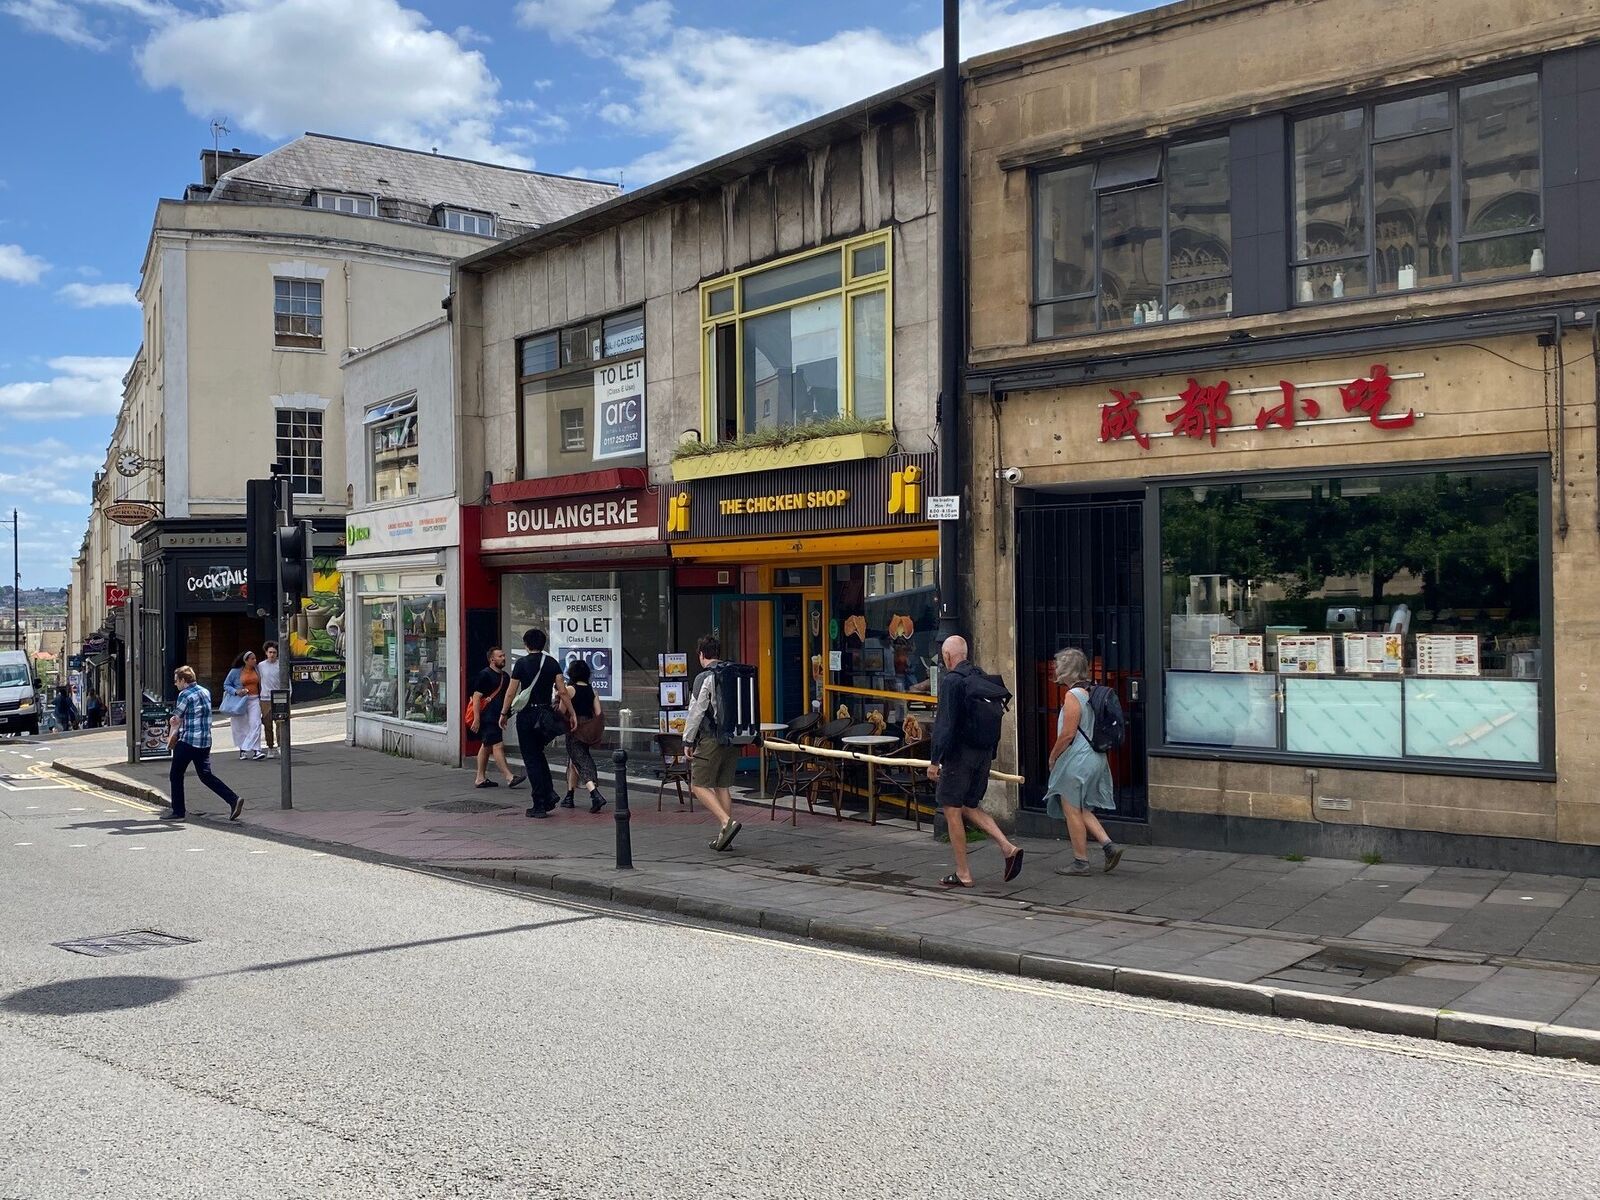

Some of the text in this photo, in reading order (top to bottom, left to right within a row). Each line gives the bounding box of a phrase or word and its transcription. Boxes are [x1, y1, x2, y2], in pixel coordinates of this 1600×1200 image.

[617, 332, 644, 347] CATERING
[600, 360, 641, 386] TO LET
[606, 400, 637, 425] arc
[1100, 364, 1415, 450] 成都小吃
[603, 432, 638, 446] 0117 252 0532
[719, 489, 848, 515] THE CHICKEN SHOP
[551, 594, 576, 602] RETAIL
[581, 594, 617, 602] CATERING
[557, 617, 612, 633] TO LET
